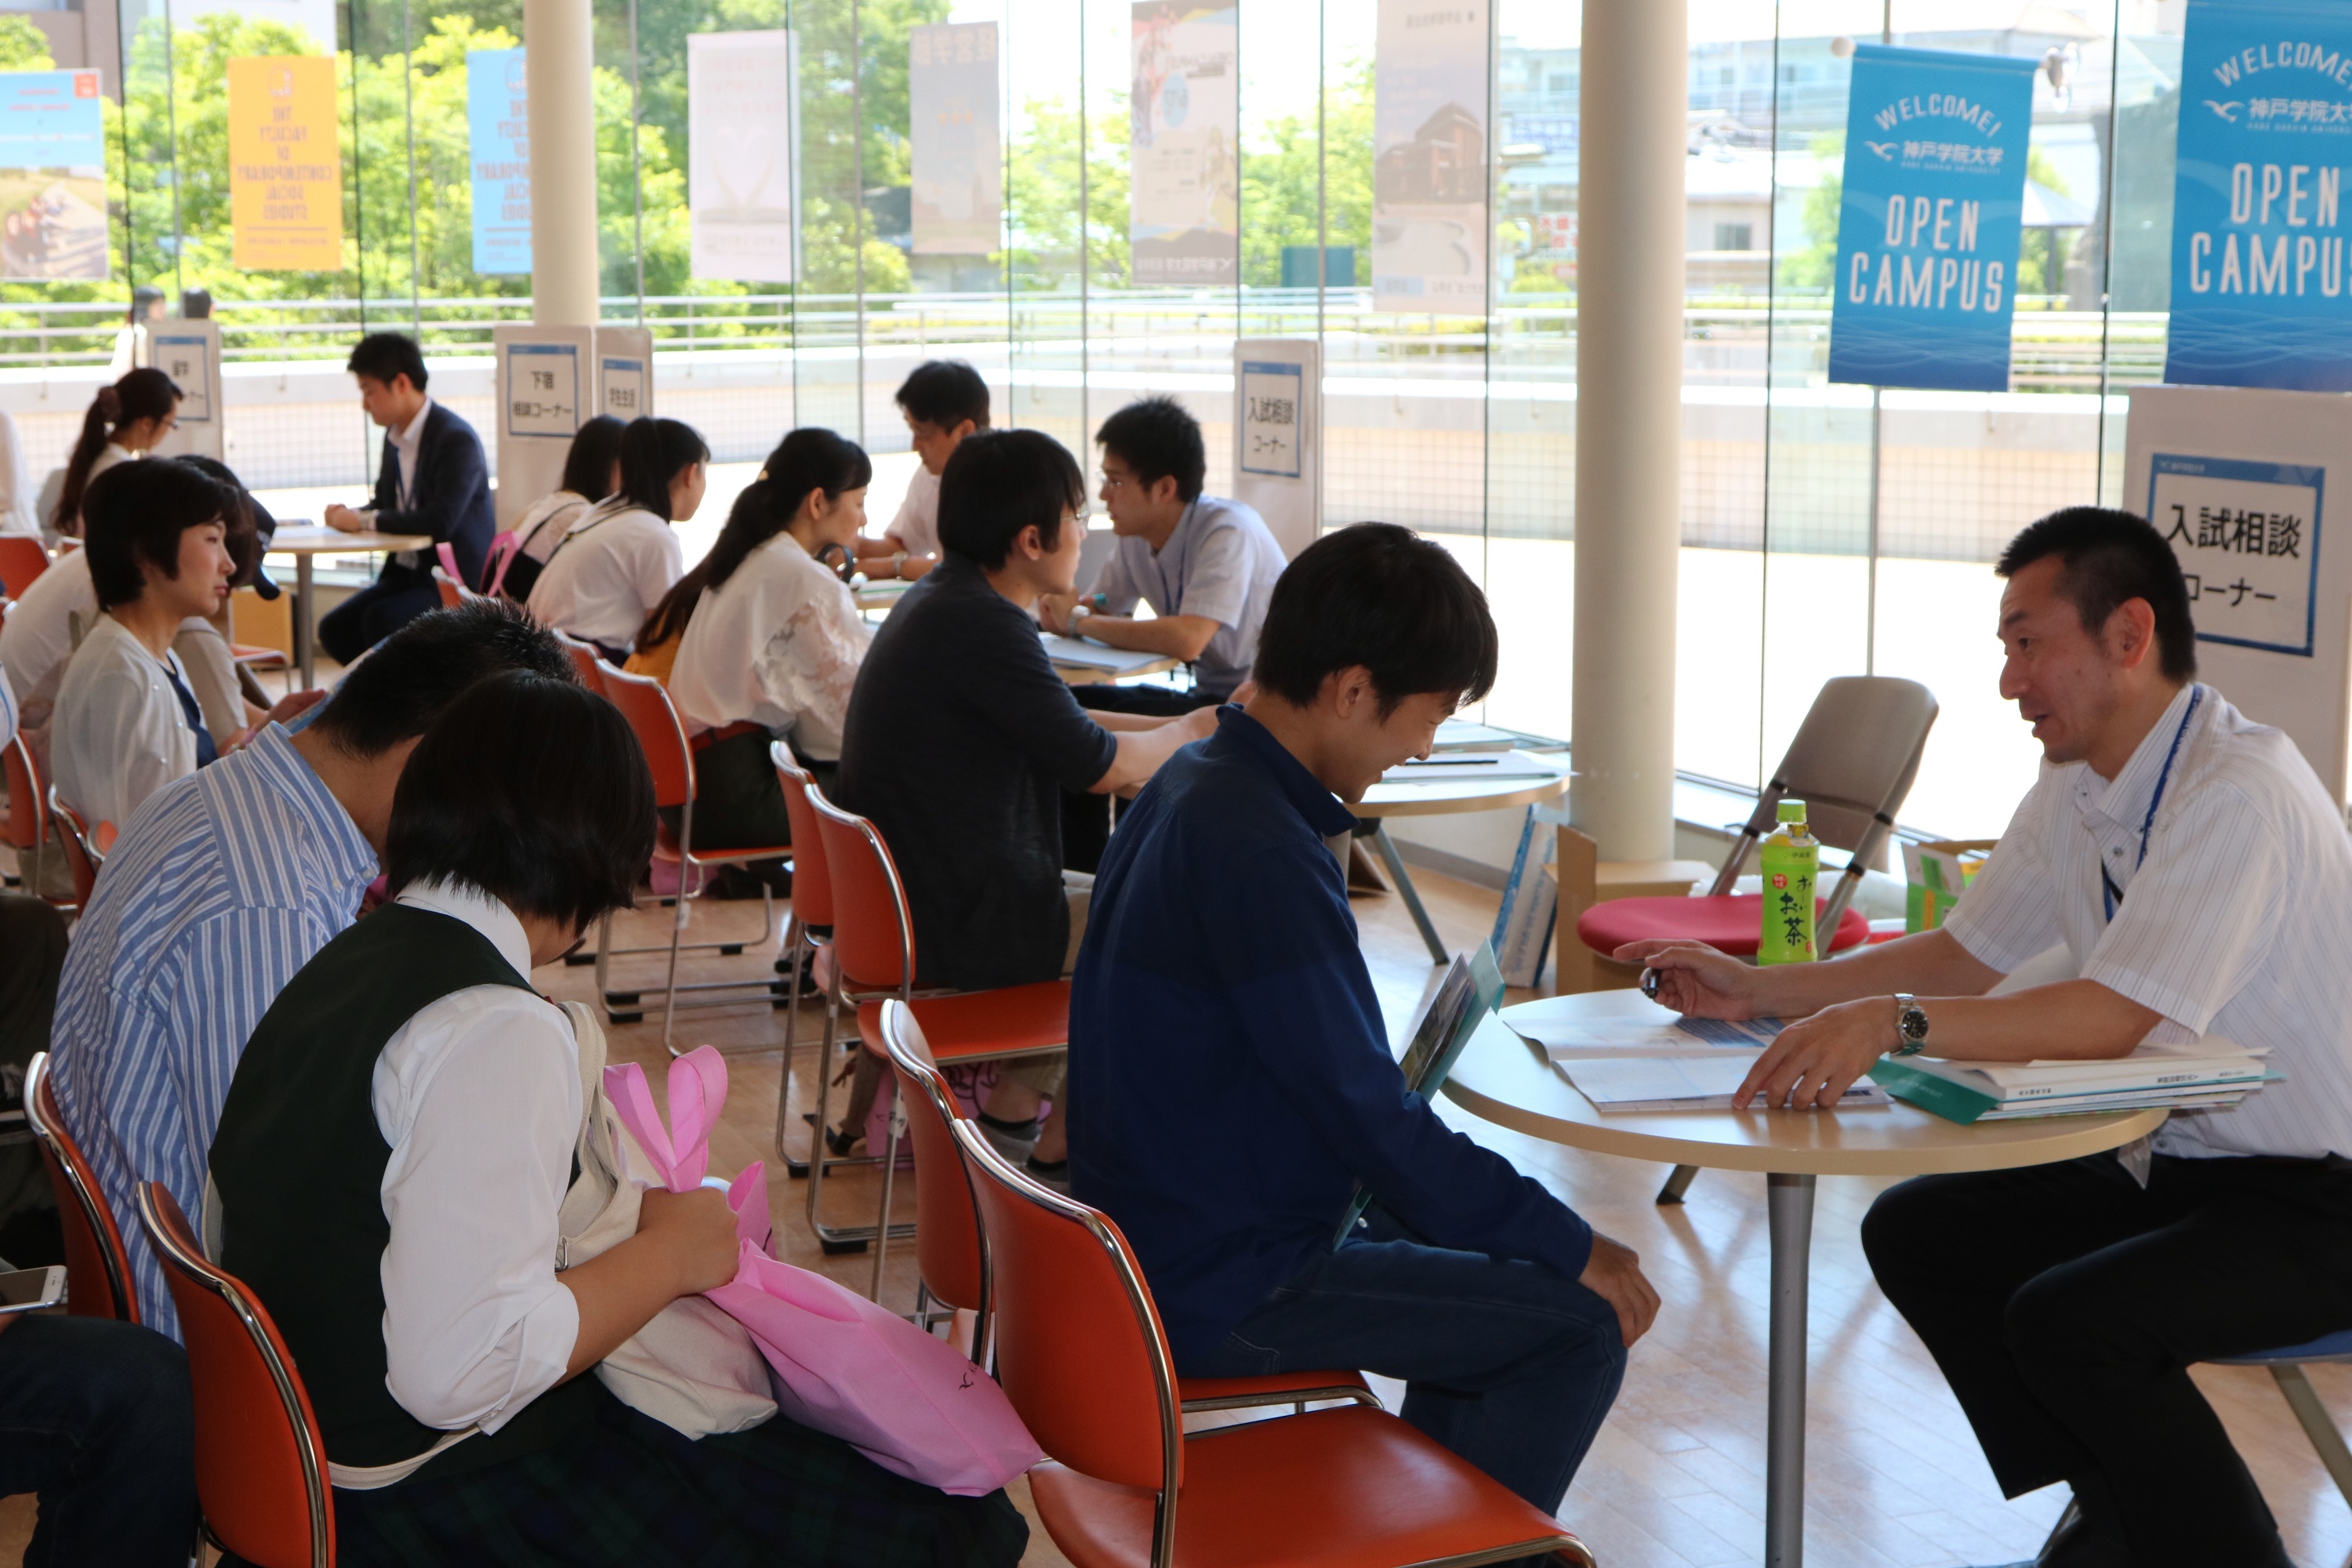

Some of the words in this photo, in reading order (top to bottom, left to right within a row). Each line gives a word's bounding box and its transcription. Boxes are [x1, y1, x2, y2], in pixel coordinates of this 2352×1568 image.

[2212, 42, 2352, 92] WELCOME
[1874, 93, 2002, 138] WELCOME!
[2249, 97, 2352, 124] 神戸学院大
[1902, 140, 2005, 167] 神戸学院大学
[2230, 162, 2340, 228] OPEN
[1886, 194, 1980, 252] OPEN
[1849, 252, 2005, 313] CAMPUS
[2190, 232, 2352, 297] CAMPU
[1248, 397, 1295, 425] 入試相談
[1254, 435, 1287, 454] コーナー
[2167, 503, 2302, 558] 入試相談
[1780, 891, 1807, 946] お茶
